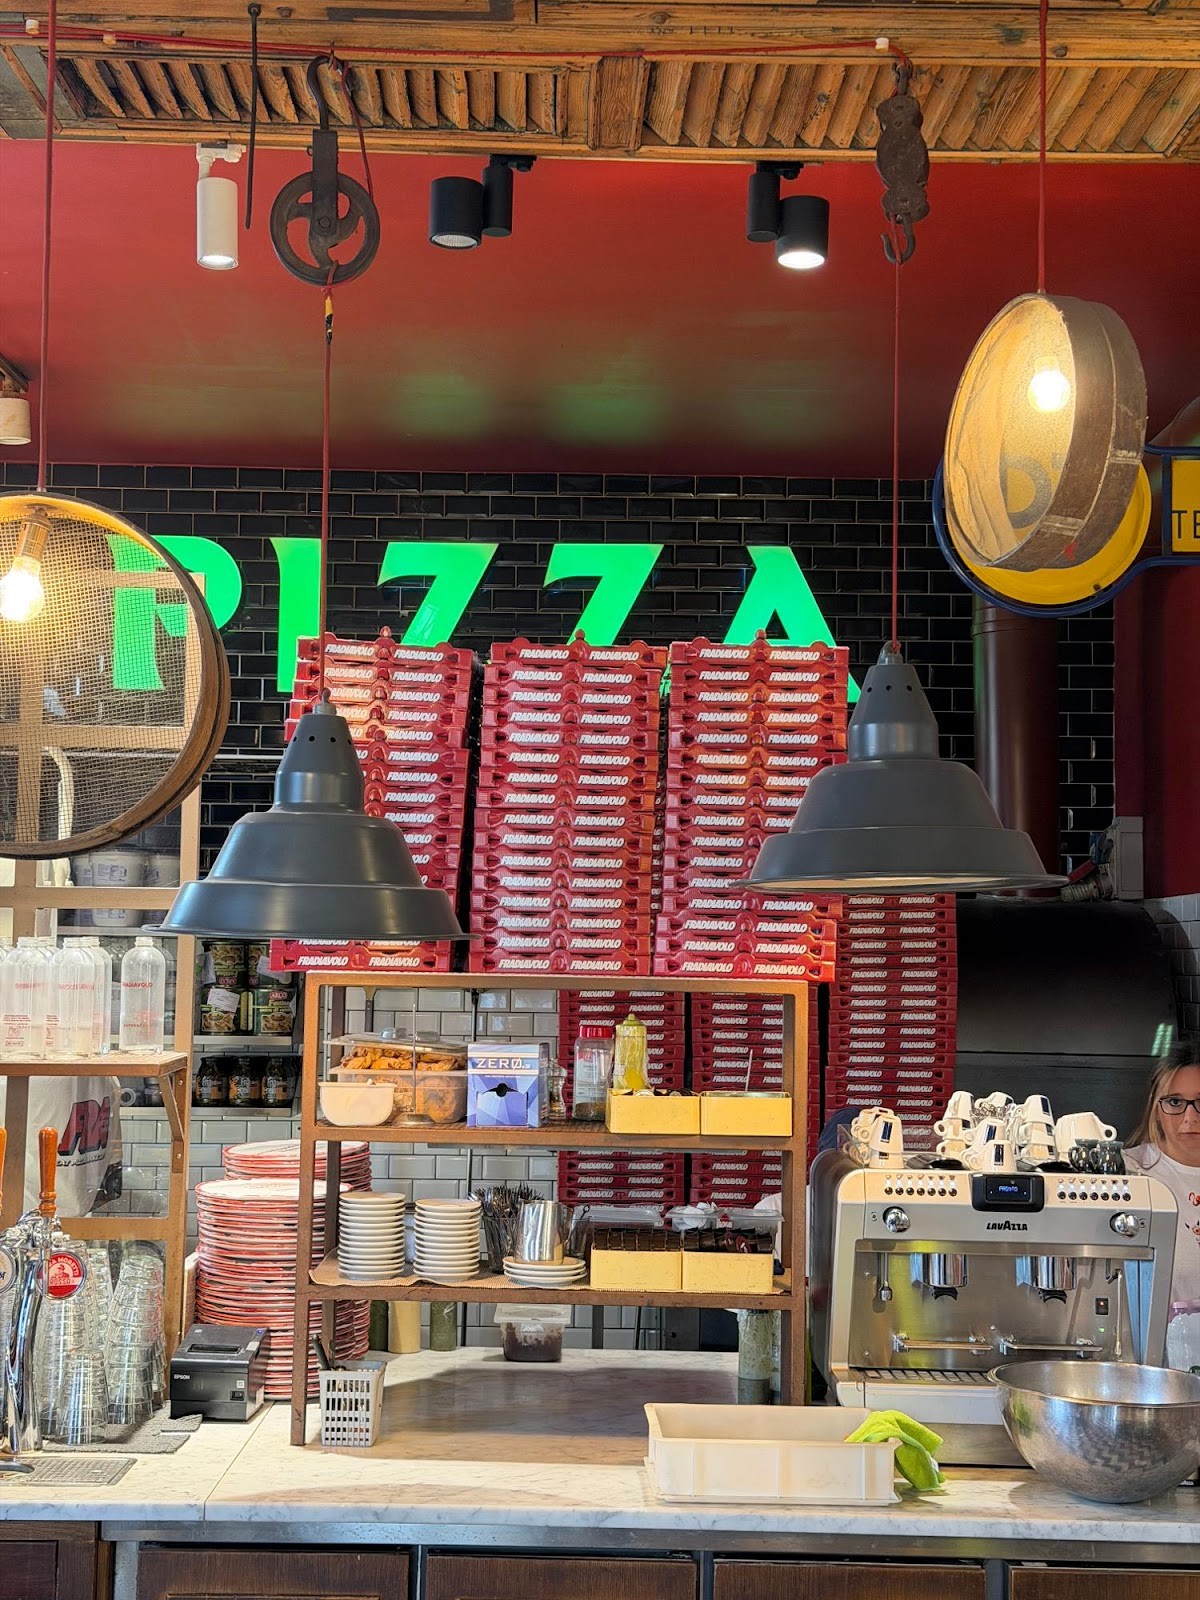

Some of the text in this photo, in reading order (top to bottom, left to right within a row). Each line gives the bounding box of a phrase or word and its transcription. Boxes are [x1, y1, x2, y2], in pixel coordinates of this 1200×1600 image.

[106, 534, 862, 702] PIZZA
[393, 650, 443, 661] FRADIAVOLO
[519, 649, 639, 661] FRADIAVOLO FRADIAVOLO
[700, 649, 820, 661] FRADIAVOLO FRADIAVOLO
[392, 671, 442, 682] FRADIAVOLO
[512, 671, 632, 683] FRADIAVOLO FRADIAVOLO
[700, 671, 820, 682] FRADIAVOLO FRADIAVOLO
[390, 691, 440, 702] FRADIAVOLO
[511, 692, 631, 704] FRADIAVOLO FRADIAVOLO
[698, 692, 818, 703] FRADIAVOLO FRADIAVOLO
[387, 711, 437, 722] FRADIAVOLO
[510, 712, 630, 724] FRADIAVOLO FRADIAVOLO
[698, 713, 818, 723] FRADIAVOLO FRADIAVOLO
[509, 733, 629, 745] FRADIAVOLO FRADIAVOLO
[698, 734, 818, 744] FRADIAVOLO FRADIAVOLO
[388, 751, 438, 762] FRADIAVOLO
[509, 753, 629, 765] FRADIAVOLO FRADIAVOLO
[697, 755, 817, 766] FRADIAVOLO FRADIAVOLO
[387, 771, 437, 782] FRADIAVOLO
[507, 773, 628, 785] FRADIAVOLO FRADIAVOLO
[696, 775, 745, 785] FRADIAVOLO
[385, 792, 435, 803] FRADIAVOLO
[505, 794, 625, 806] FRADIAVOLO FRADIAVOLO
[696, 796, 803, 806] FRADIAVOLO FRADIAV
[503, 815, 624, 826] FRADIAVOLO FRADIAVOLO
[694, 816, 744, 827] FRADIAVOLO
[503, 835, 624, 847] FRADIAVOLO FRADIAVOLO
[694, 837, 743, 848] FRADIAVOLO
[501, 856, 622, 868] FRADIAVOLO FRADIAVOLO
[692, 857, 742, 868] FRADIAVOLO
[501, 877, 622, 888] FRADIAVOLO FRADIAVOLO
[500, 897, 621, 908] FRADIAVOLO FRADIAVOLO
[692, 899, 812, 911] FRADIAVOLO FRADIAVOLO
[499, 918, 620, 929] FRADIAVOLO FRADIAVOLO
[686, 921, 807, 933] FRADIAVOLO FRADIAVOLO
[499, 938, 620, 949] FRADIAVOLO FRADIAVOLO
[684, 942, 806, 954] FRADIAVOLO FRADIAVOLO
[298, 956, 420, 967] FRADIAVOLO FRADIAVOLO
[499, 959, 620, 971] FRADIAVOLO FRADIAVOLO
[683, 963, 804, 975] FRADIAVOLO FRADIAVOLO
[986, 1220, 1028, 1230] LAVAZZA
